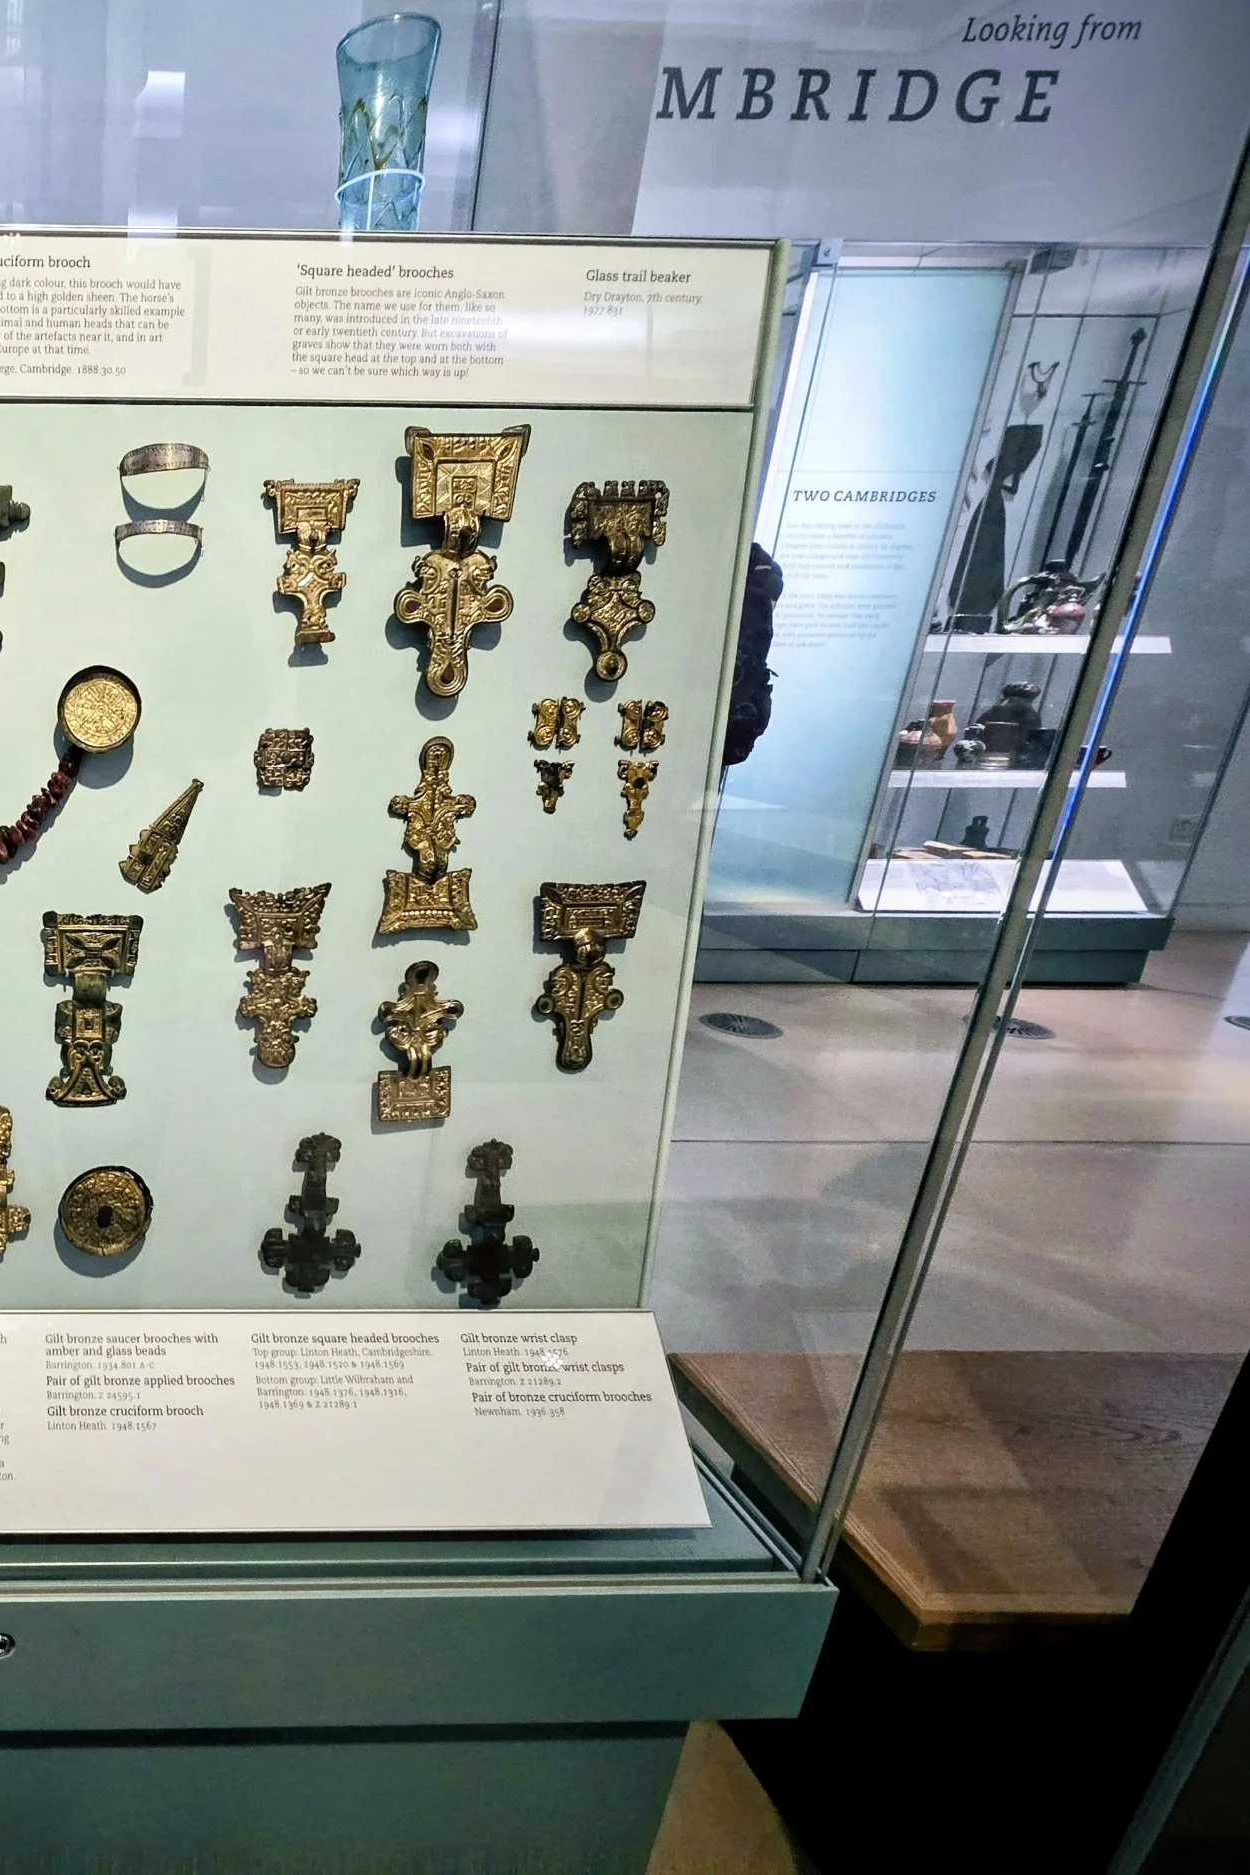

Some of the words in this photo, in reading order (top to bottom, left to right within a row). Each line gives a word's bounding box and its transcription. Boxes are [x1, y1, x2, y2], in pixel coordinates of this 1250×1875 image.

[961, 15, 1069, 49] Looking
[1071, 14, 1143, 49] from
[655, 67, 1060, 124] MBRIDGE
[47, 255, 91, 268] brooch
[398, 265, 454, 278] brooches
[585, 269, 619, 281] Glass
[621, 270, 647, 282] trail
[649, 270, 692, 283] beaker
[583, 291, 602, 304] Dry
[793, 490, 831, 502] TWO
[833, 490, 937, 503] CAMBRIDGES
[44, 1332, 64, 1344] Gilt
[65, 1332, 104, 1344] bronze
[105, 1335, 141, 1343] saucer
[142, 1332, 192, 1343] brooches
[193, 1332, 219, 1343] with
[250, 1332, 271, 1343] Gilt
[271, 1332, 309, 1343] bronze
[311, 1335, 348, 1346] square
[349, 1332, 390, 1343] headed
[390, 1331, 440, 1343] brooches
[460, 1332, 480, 1343] Gilt
[480, 1332, 518, 1343] bronze
[519, 1332, 549, 1343] wrist
[549, 1332, 578, 1345] clasp
[45, 1344, 80, 1356] amber
[82, 1344, 103, 1356] and
[105, 1344, 133, 1358] glass
[134, 1344, 167, 1356] beads
[466, 1361, 486, 1372] Pair
[489, 1361, 500, 1372] of
[503, 1361, 520, 1375] gilt
[563, 1361, 589, 1373] wrist
[591, 1361, 625, 1375] clasps
[46, 1374, 67, 1386] Pair
[69, 1374, 81, 1386] of
[83, 1374, 101, 1388] gilt
[103, 1374, 141, 1386] bronze
[143, 1374, 184, 1388] applied
[185, 1373, 235, 1385] brooches
[471, 1391, 493, 1402] Pair
[494, 1391, 507, 1402] of
[507, 1391, 546, 1402] bronze
[547, 1390, 602, 1402] cruciform
[601, 1390, 652, 1402] brooches
[46, 1404, 67, 1416] Gilt
[68, 1404, 107, 1416] bronze
[109, 1404, 163, 1416] cruciform
[165, 1404, 204, 1416] brooch
